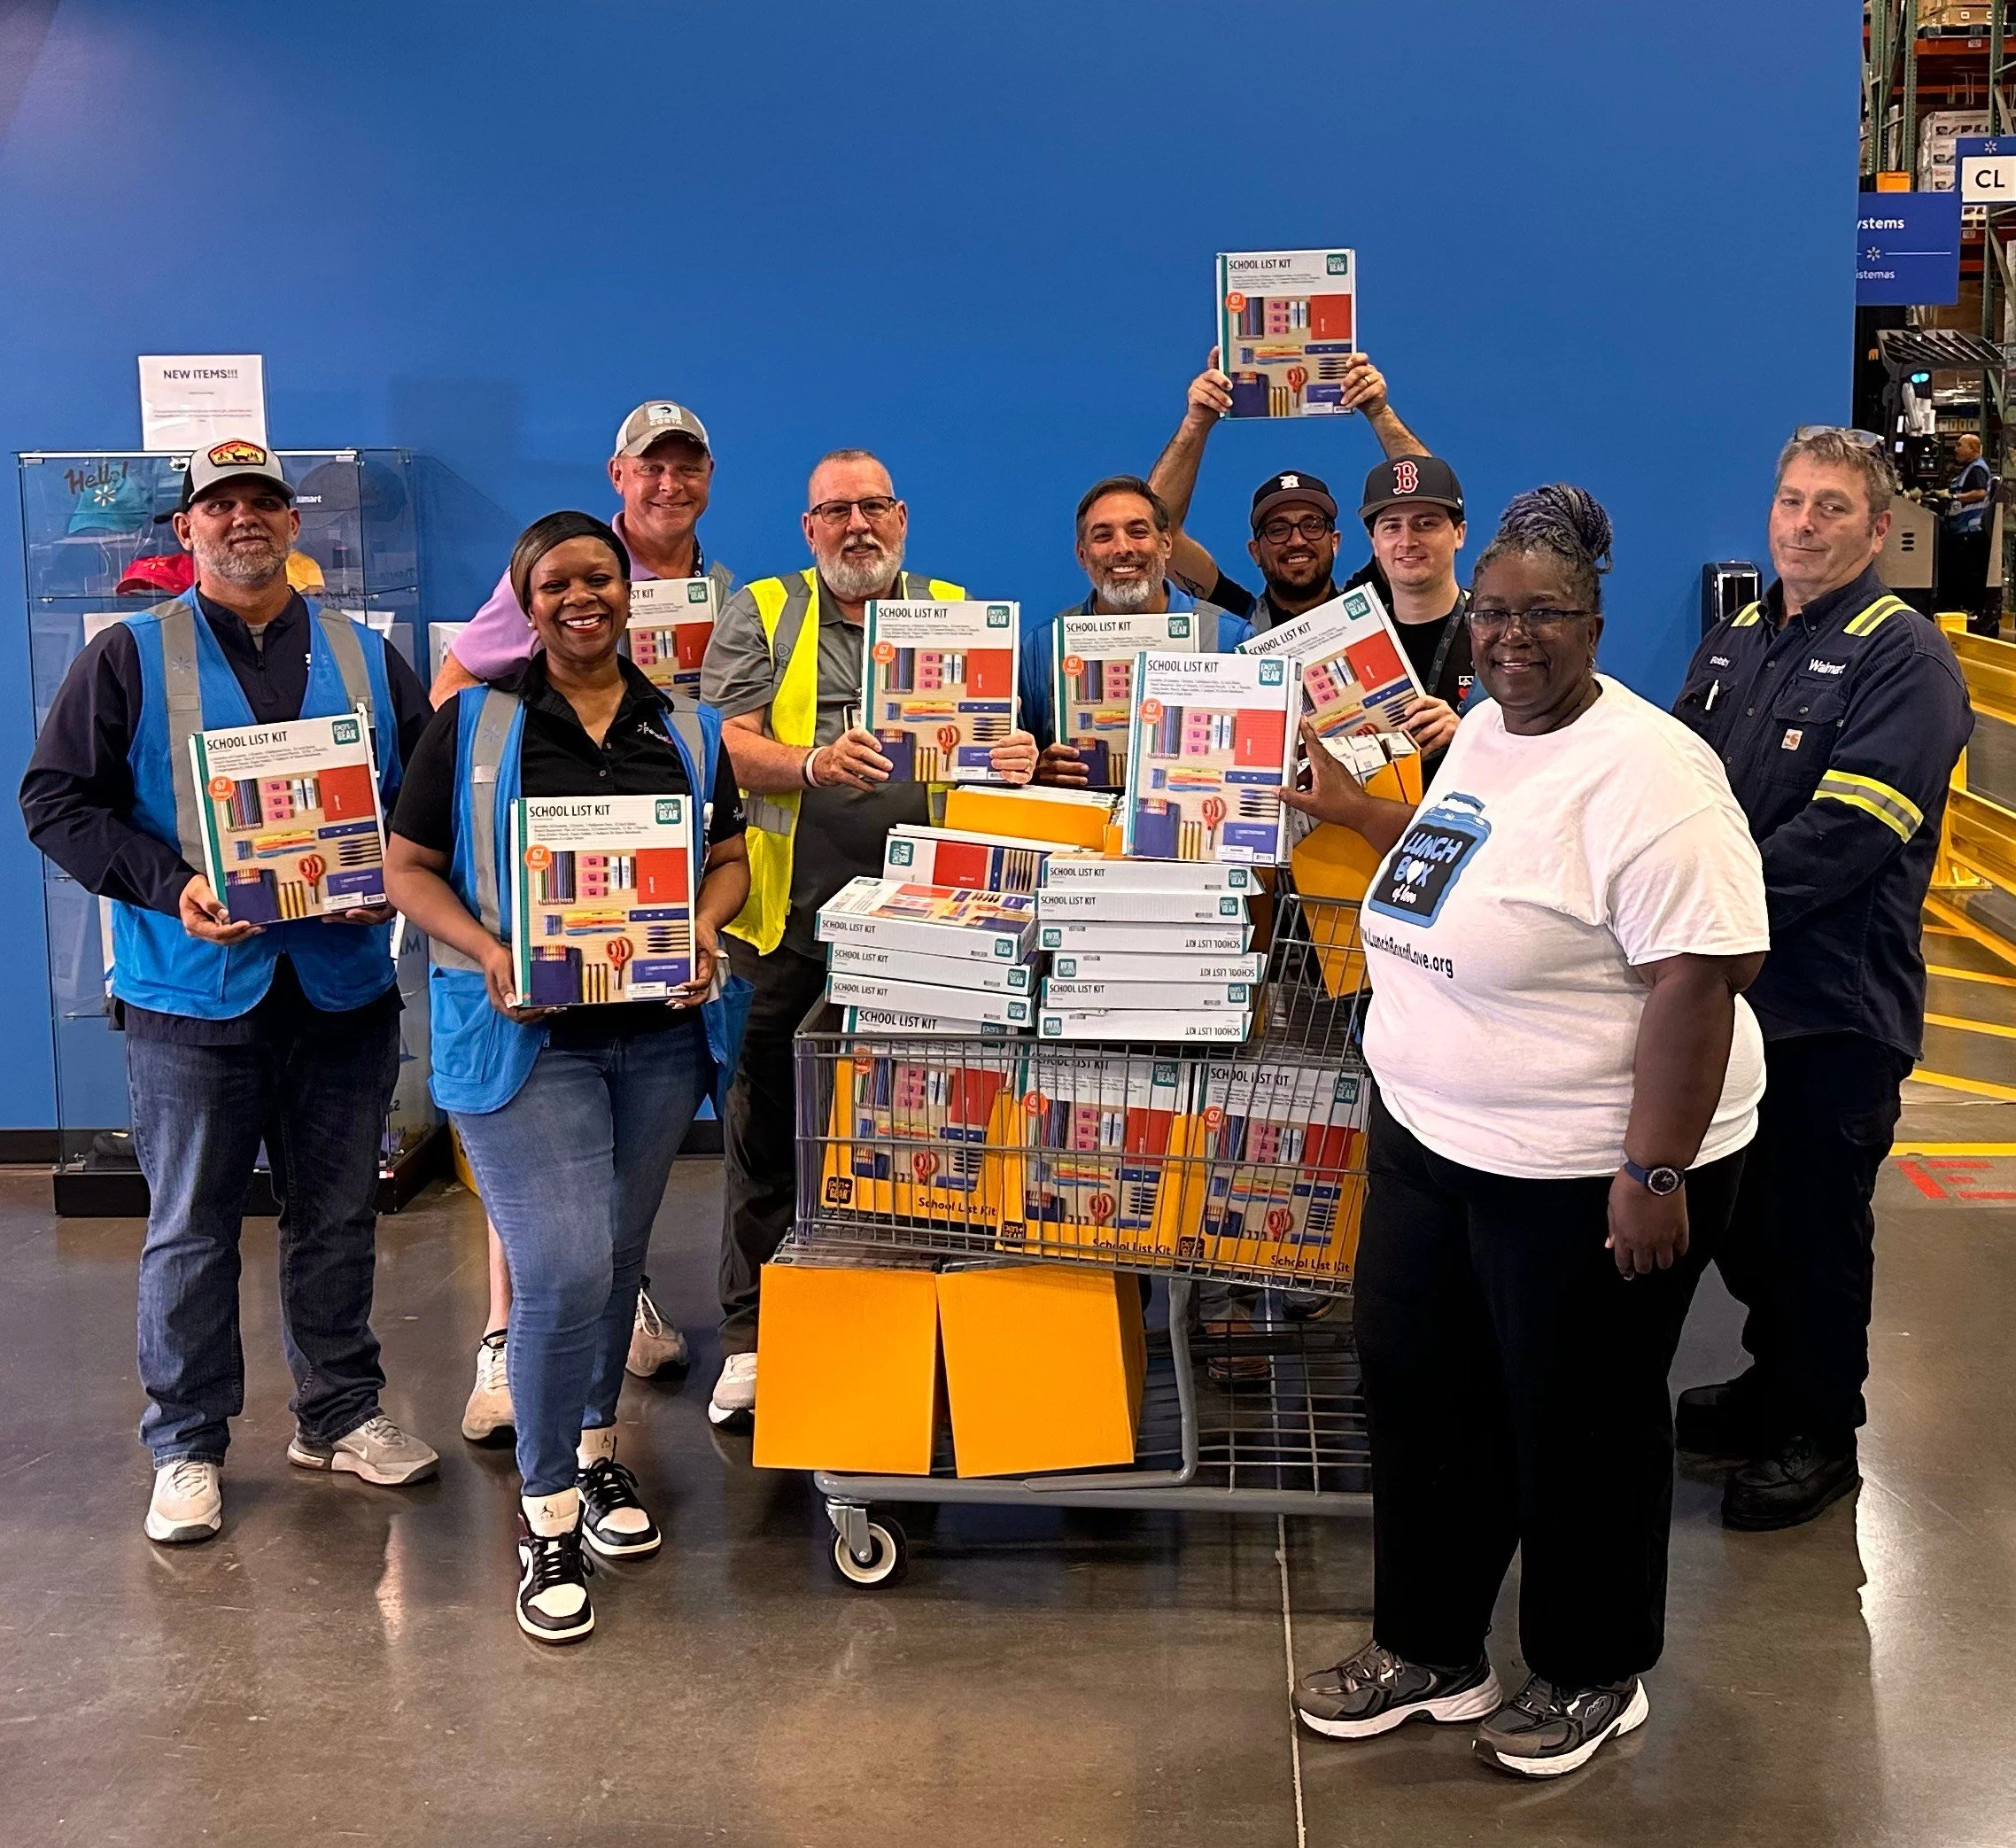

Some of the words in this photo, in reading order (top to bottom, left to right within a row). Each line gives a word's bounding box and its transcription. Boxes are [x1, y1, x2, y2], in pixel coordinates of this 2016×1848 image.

[1975, 169, 2005, 189] CL
[1229, 259, 1259, 270] SCHOOL
[1260, 259, 1277, 269] LIST
[1278, 258, 1291, 268] KIT
[163, 369, 190, 380] NEW
[193, 369, 238, 379] ITEMS!!!
[1392, 460, 1419, 494] B
[642, 587, 654, 599] KIT
[879, 608, 912, 618] SCHOOL
[914, 608, 932, 617] LIST
[934, 608, 948, 617] KIT
[1066, 623, 1097, 633] SCHOOL
[1099, 622, 1116, 632] LIST
[1118, 621, 1131, 631] KIT
[1248, 637, 1282, 655] SCHOOL
[1280, 628, 1297, 643] LIST
[1298, 622, 1312, 635] KIT
[1148, 660, 1182, 672] SCHOOL
[1183, 661, 1203, 672] LIST
[1205, 662, 1219, 673] KIT
[206, 734, 247, 751] SCHOOL
[249, 734, 269, 745] LIST
[272, 731, 288, 743] KIT
[529, 806, 570, 818] SCHOOL
[571, 805, 593, 816] LIST
[594, 804, 610, 815] KIT
[1402, 832, 1463, 864] LUNCH
[1050, 867, 1076, 876] SCHOOL
[1041, 896, 1067, 905] SCHOOL
[1069, 896, 1083, 905] LIST
[822, 919, 848, 931] SCHOOL
[849, 922, 864, 932] LIST
[865, 924, 875, 933] KIT
[1198, 939, 1212, 948] LIST
[1214, 939, 1240, 948] SCHOOL
[834, 949, 861, 960] SCHOOL
[862, 952, 876, 961] LIST
[877, 954, 888, 963] KIT
[834, 982, 860, 992] SCHOOL
[861, 985, 875, 995] LIST
[877, 987, 888, 996] KIT
[1050, 984, 1076, 993] SCHOOL
[1078, 984, 1093, 993] LIST
[1094, 984, 1105, 993] KIT
[859, 1009, 897, 1024] SCHOOL
[899, 1013, 919, 1028] LIST
[921, 1017, 938, 1030] KIT
[1185, 1026, 1197, 1035] KIT
[1157, 1071, 1176, 1083] GEAR
[1211, 1068, 1249, 1083] SCHOOL
[1208, 1110, 1221, 1121] 67
[918, 1197, 956, 1211] School
[958, 1202, 978, 1214] Lst
[1093, 1238, 1129, 1251] School
[1270, 1254, 1308, 1268] School
[1312, 1259, 1330, 1270] Lst
